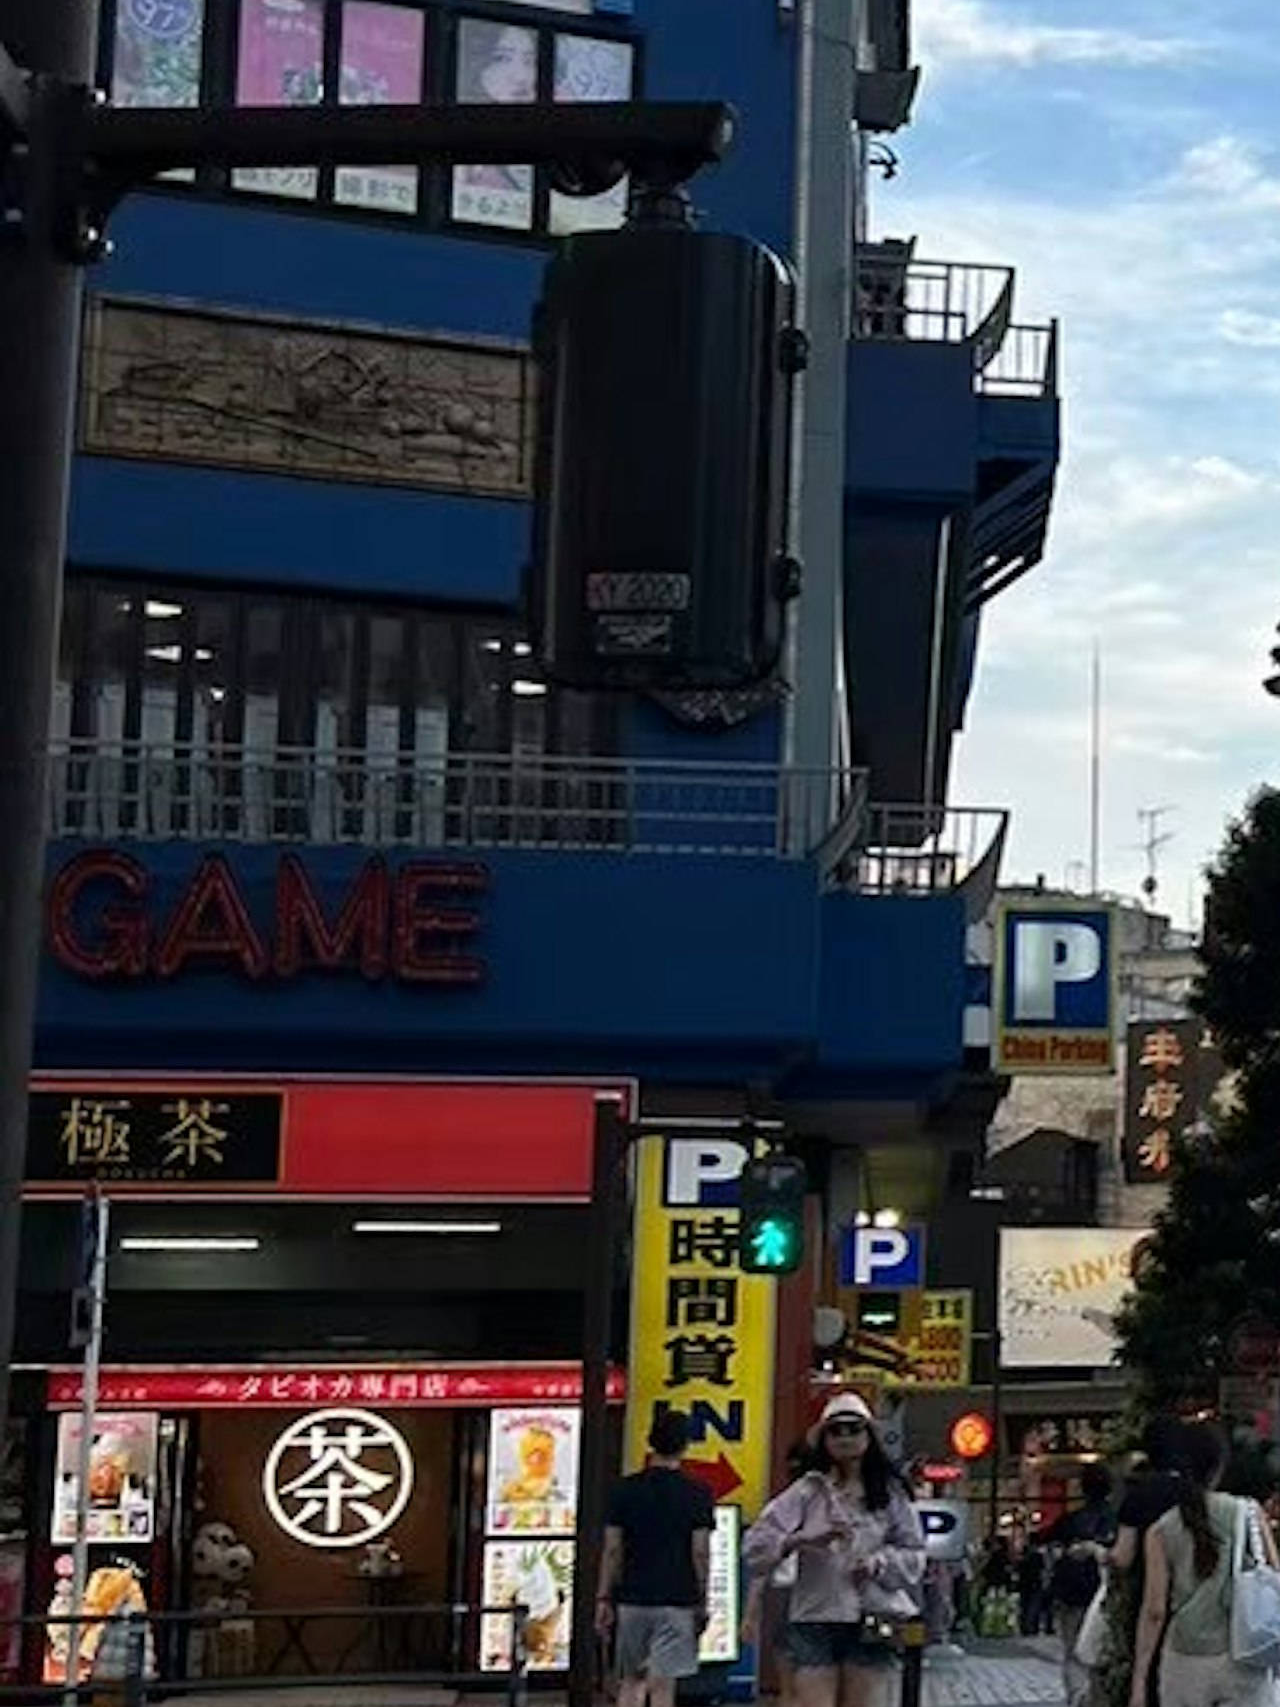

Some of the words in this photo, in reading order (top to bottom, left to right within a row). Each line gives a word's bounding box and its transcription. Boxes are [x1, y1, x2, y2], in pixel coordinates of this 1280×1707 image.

[49, 849, 490, 983] GAME
[1014, 922, 1100, 1020] P
[1049, 1036, 1108, 1063] Parking
[60, 1097, 231, 1166] 極茶
[667, 1138, 748, 1205] P
[853, 1227, 910, 1284] P
[663, 1216, 741, 1388] 時間貸
[279, 1424, 394, 1534] 茶
